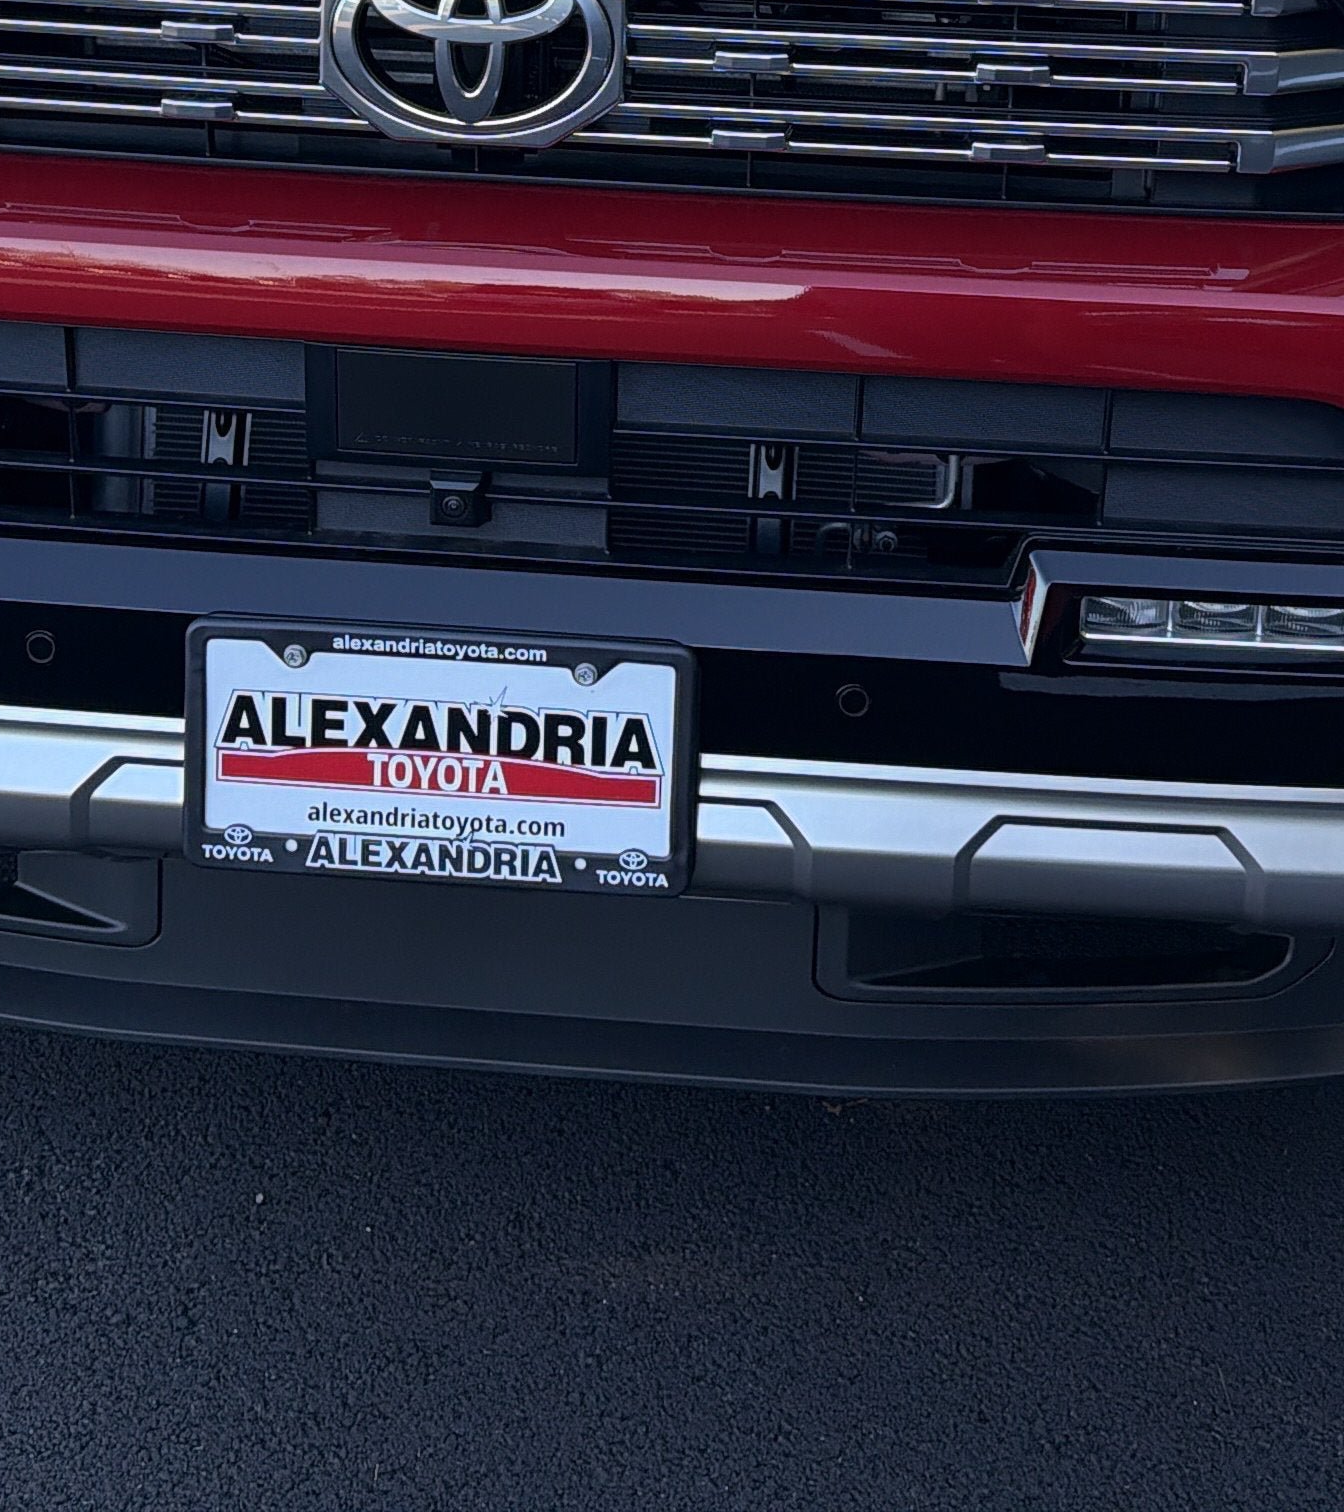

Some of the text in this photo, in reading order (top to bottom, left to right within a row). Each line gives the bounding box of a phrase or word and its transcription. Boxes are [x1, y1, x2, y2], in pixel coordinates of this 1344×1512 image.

[332, 634, 547, 663] alexandriatoyota.com
[219, 693, 658, 772] ALEXANDRIA
[367, 753, 508, 794] TOYOTA
[307, 802, 565, 838] alexandriatoyota.com
[202, 843, 274, 864] TOYOTA
[308, 834, 560, 882] ALEXANDRIA
[595, 869, 668, 889] TOYOTA
